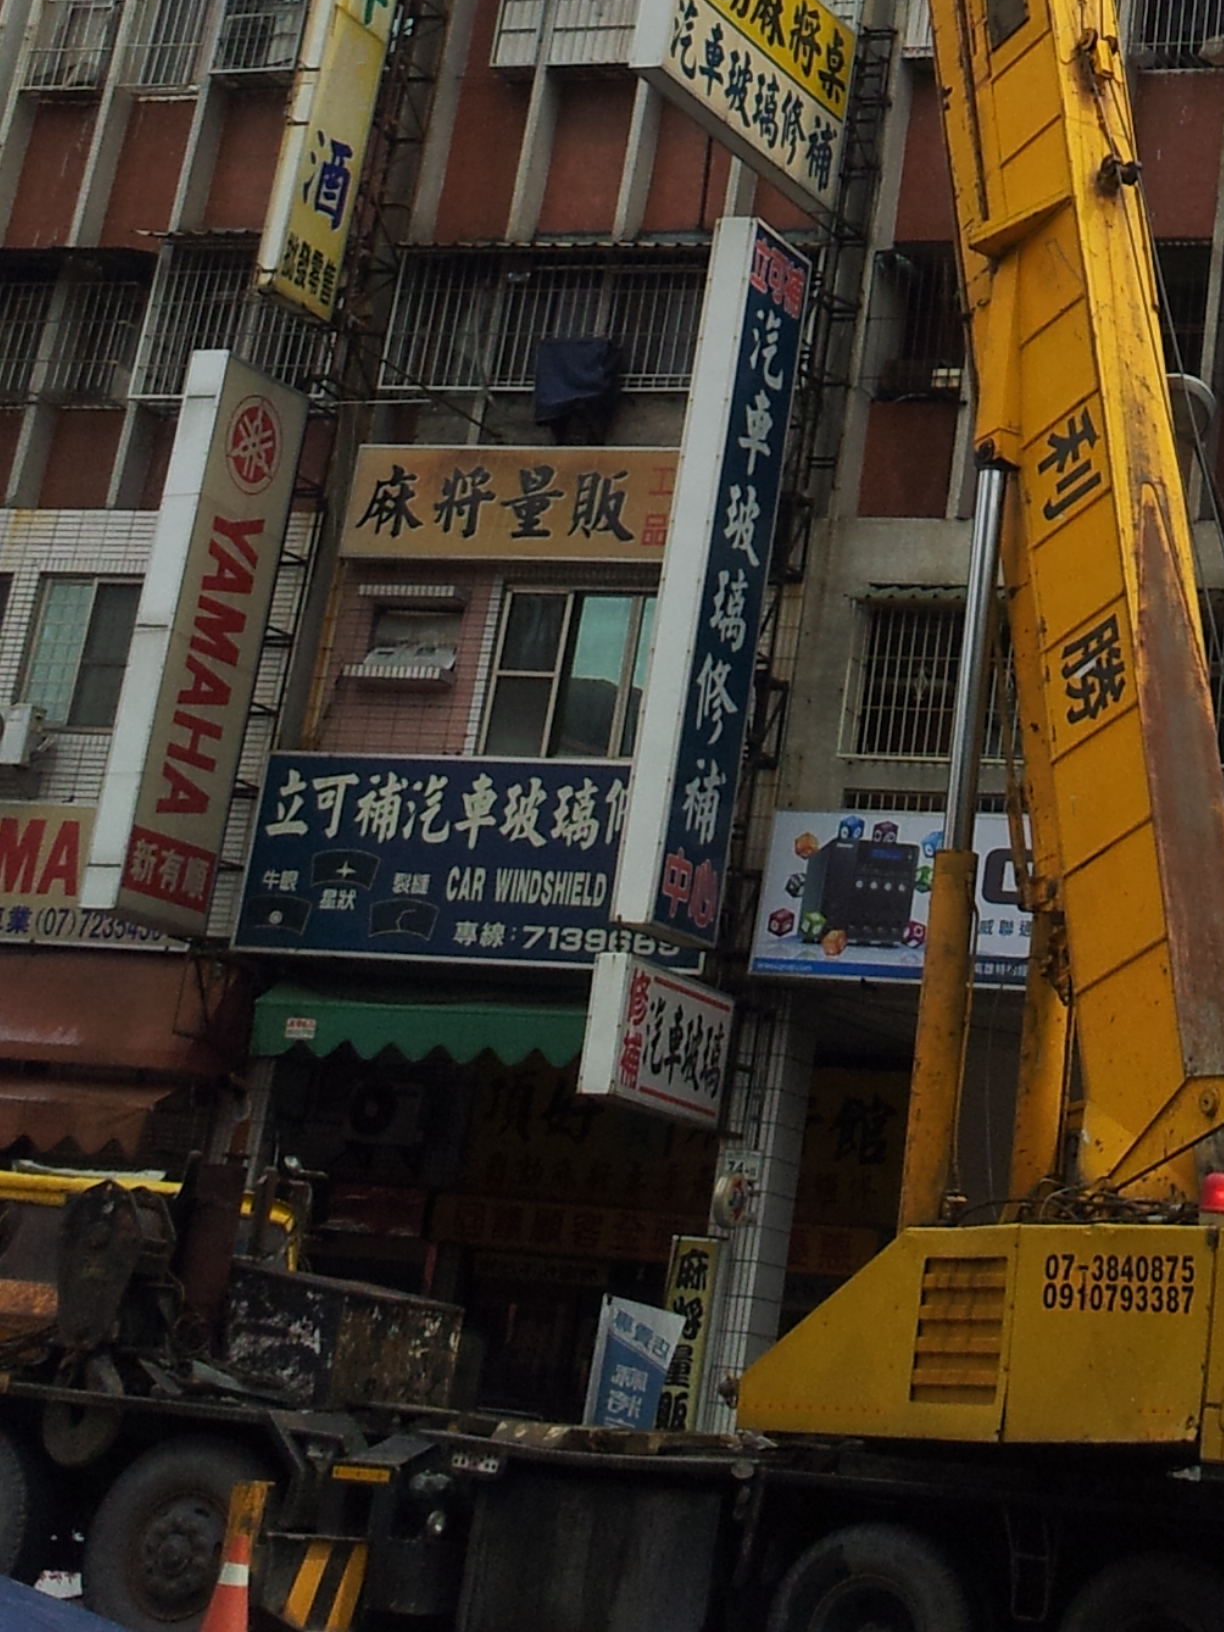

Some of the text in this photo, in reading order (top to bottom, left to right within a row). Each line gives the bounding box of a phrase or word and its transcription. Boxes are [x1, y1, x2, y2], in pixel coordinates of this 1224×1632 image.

[356, 465, 634, 542] 麻將量販
[682, 309, 784, 845] 汽車玻璃修補
[156, 516, 265, 813] YAMAHA
[446, 865, 607, 908] CAR WINDSHIELD
[662, 846, 718, 928] 中心
[642, 996, 725, 1099] 汽車玻璃
[1043, 1282, 1195, 1314] 0910793387
[1045, 1254, 1195, 1283] 07-3840875
